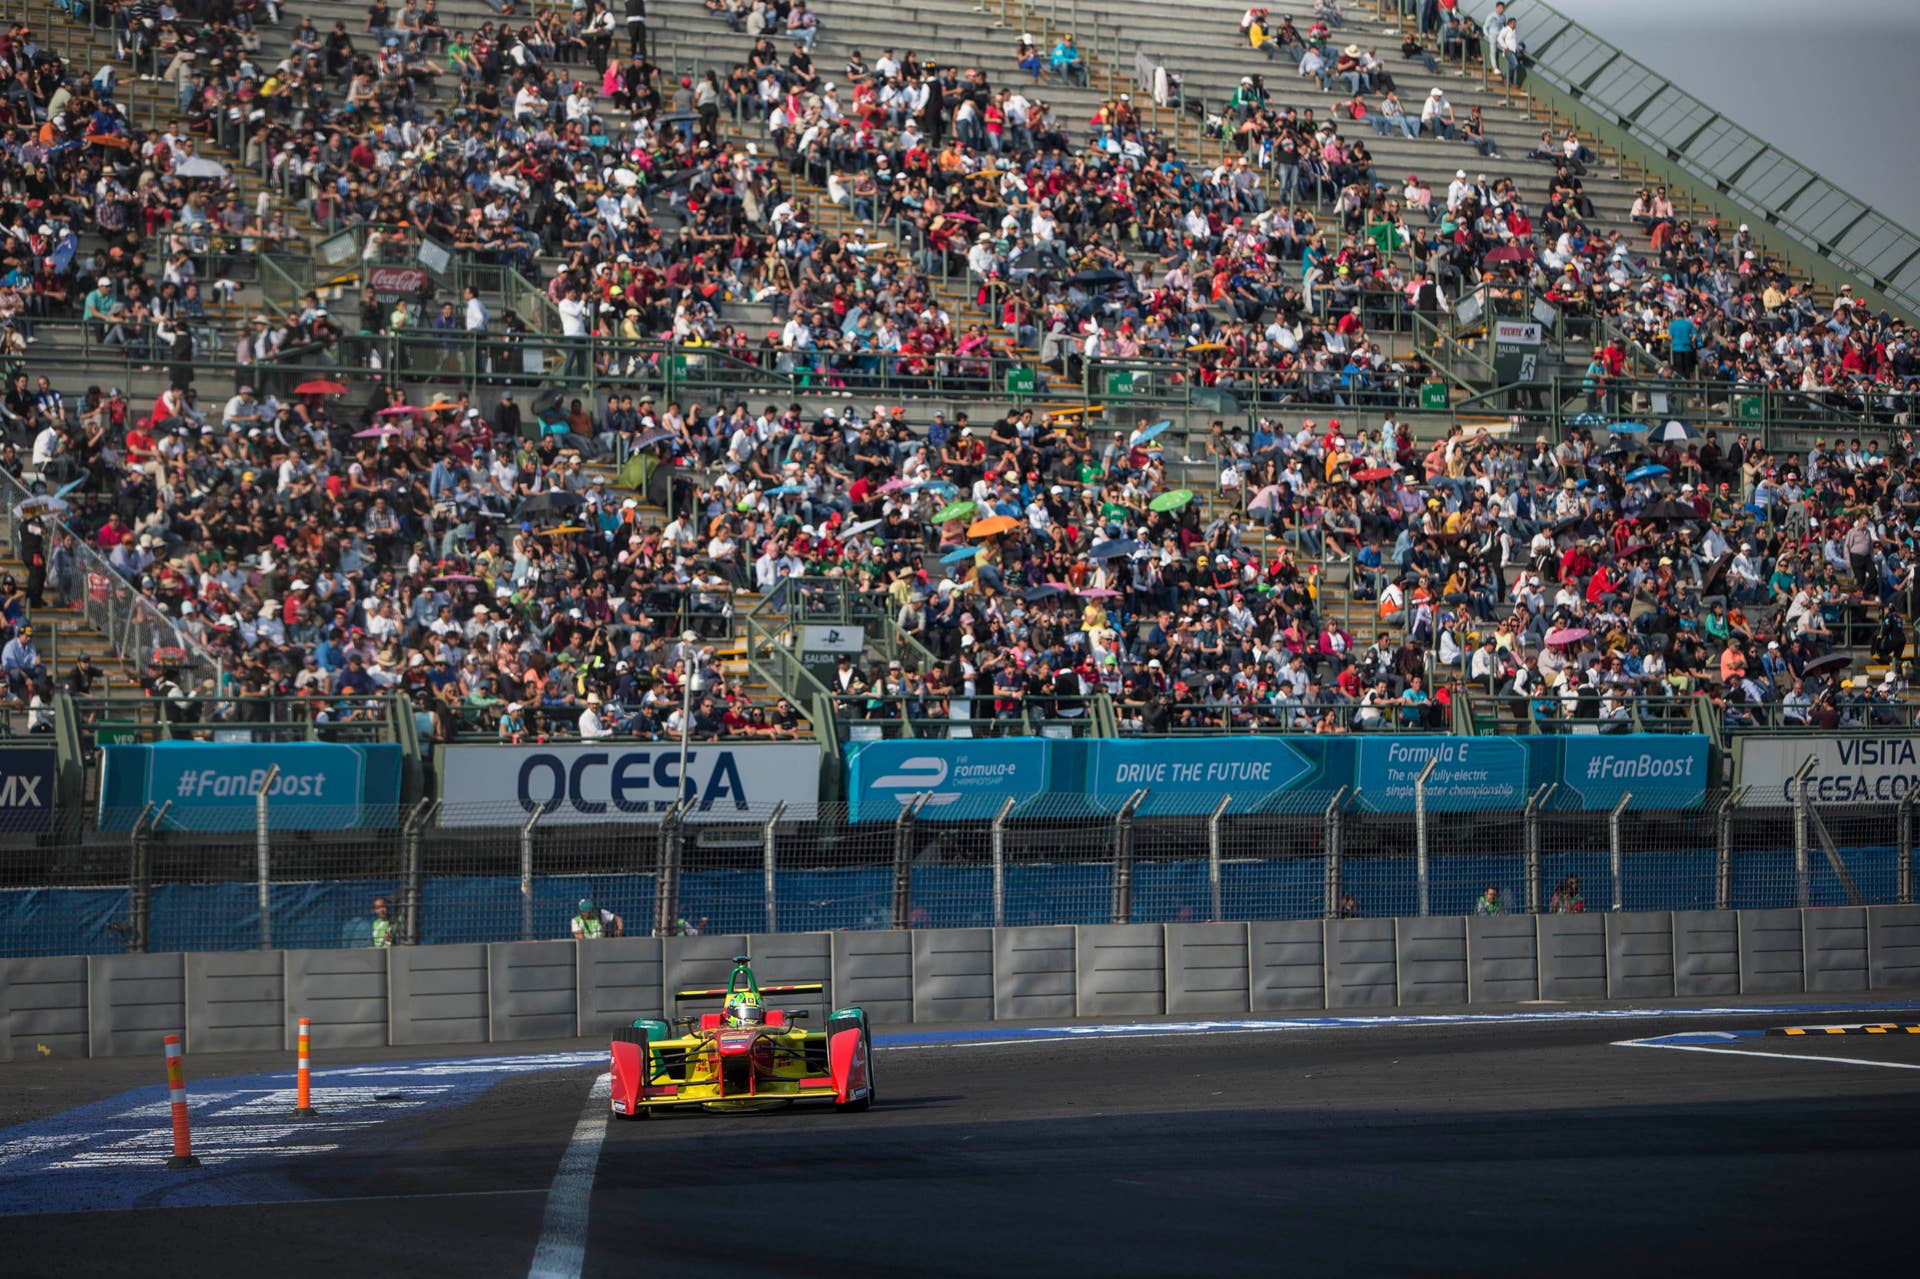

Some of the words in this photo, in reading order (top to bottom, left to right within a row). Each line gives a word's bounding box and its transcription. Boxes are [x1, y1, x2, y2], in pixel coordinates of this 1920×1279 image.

[804, 654, 834, 663] SALIDA
[1388, 742, 1453, 762] Formula
[1458, 743, 1469, 762] E
[1836, 739, 1916, 766] VISITA
[1116, 763, 1166, 783] DRIVE
[1171, 763, 1202, 782] THE
[1207, 761, 1272, 781] FUTURE
[1388, 769, 1405, 781] The
[1587, 754, 1694, 780] #FanBoost
[177, 769, 326, 797] #FanBoost
[517, 751, 749, 814] OCESA
